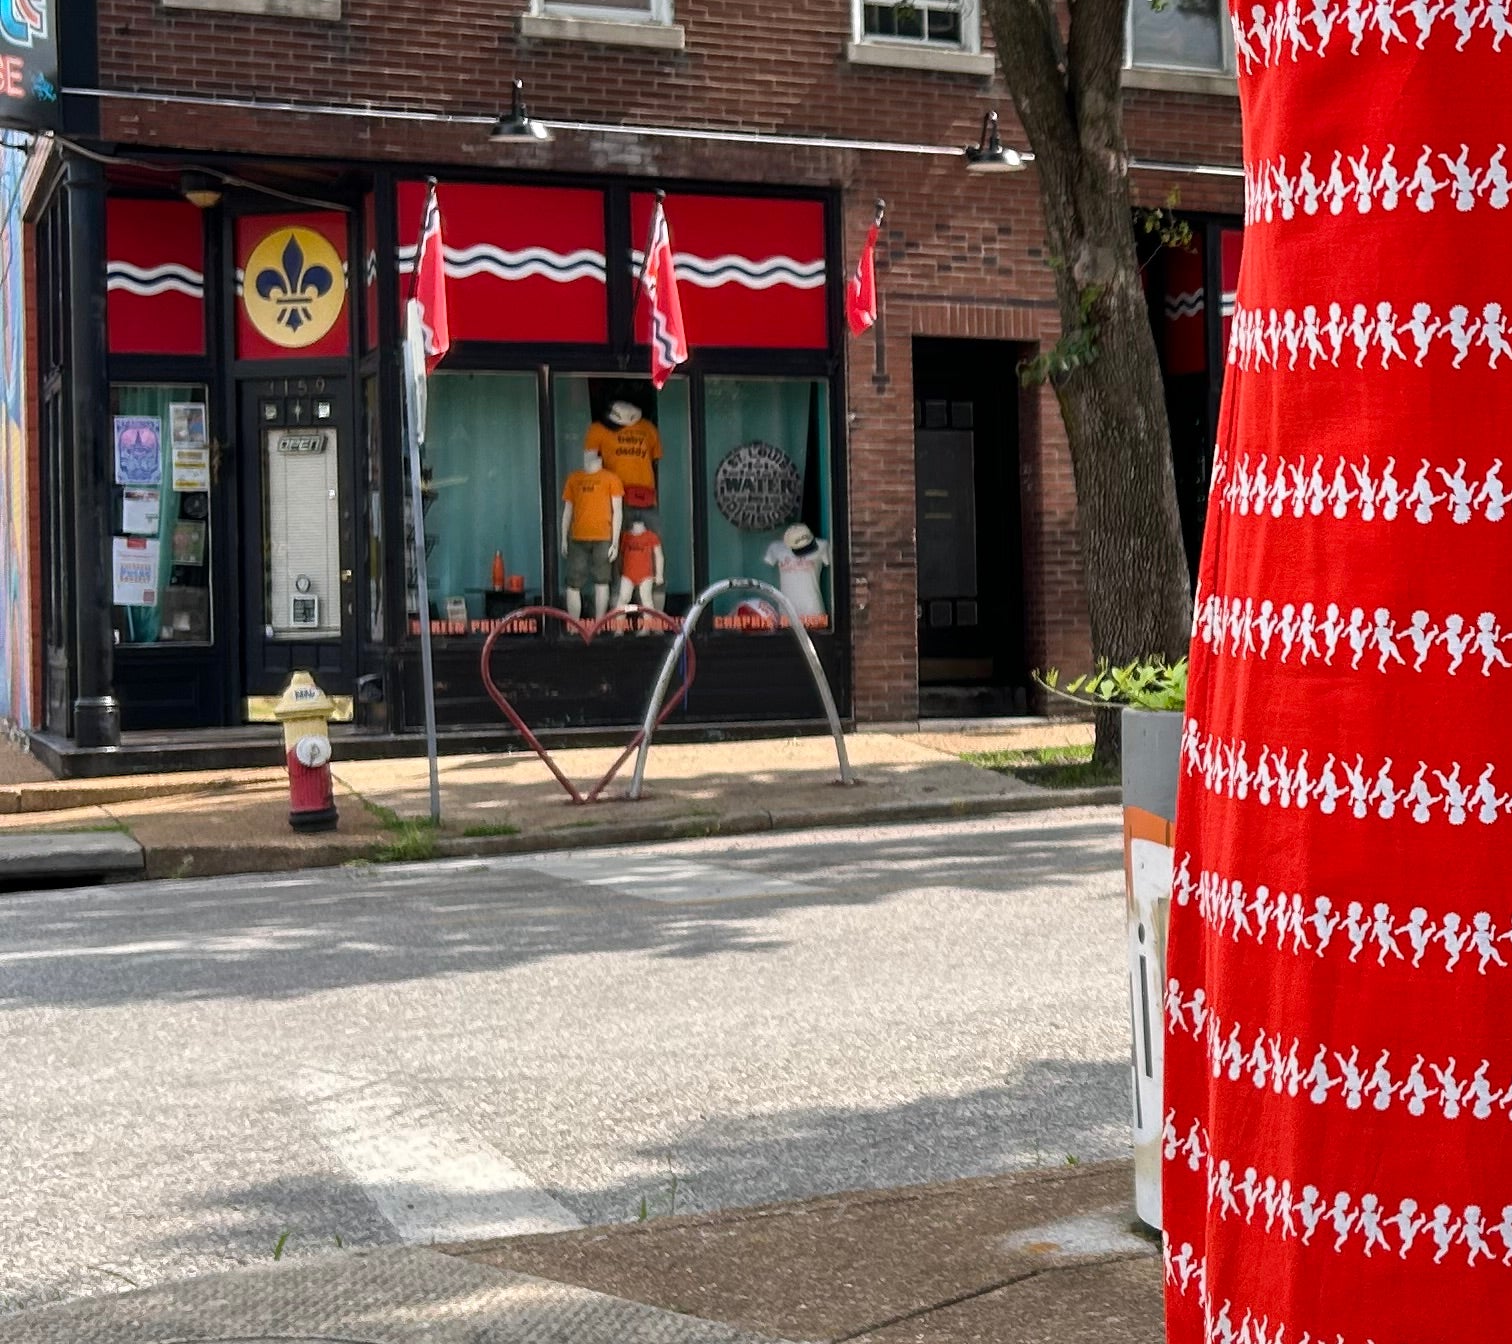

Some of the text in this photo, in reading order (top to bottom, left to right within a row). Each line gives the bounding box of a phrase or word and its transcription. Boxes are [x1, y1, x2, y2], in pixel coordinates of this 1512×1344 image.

[279, 438, 321, 453] OPEN
[615, 445, 648, 458] daddy
[724, 477, 798, 495] WATER
[411, 618, 465, 635] SREEN
